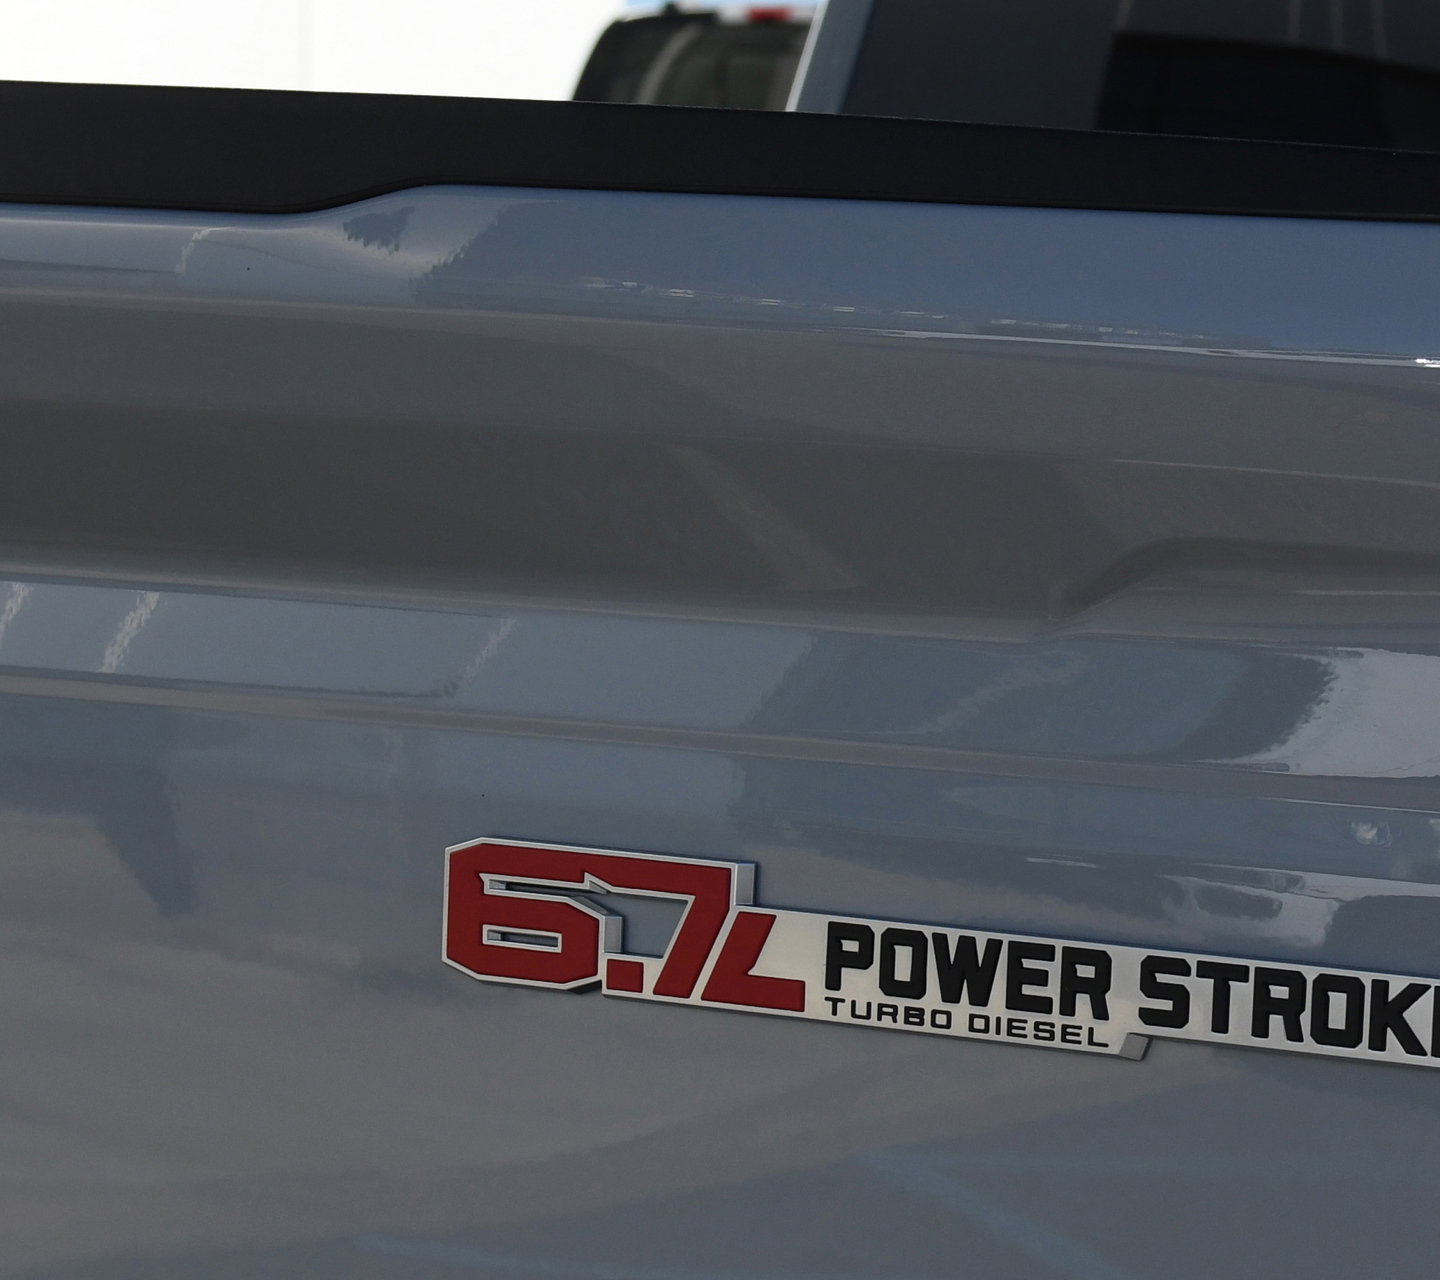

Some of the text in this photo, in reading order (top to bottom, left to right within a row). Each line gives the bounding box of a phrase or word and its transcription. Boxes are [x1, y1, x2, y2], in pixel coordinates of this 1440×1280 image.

[443, 836, 806, 1013] 6.7L
[824, 920, 1112, 1021] POWER
[824, 996, 1111, 1049] TURBO DIESEL
